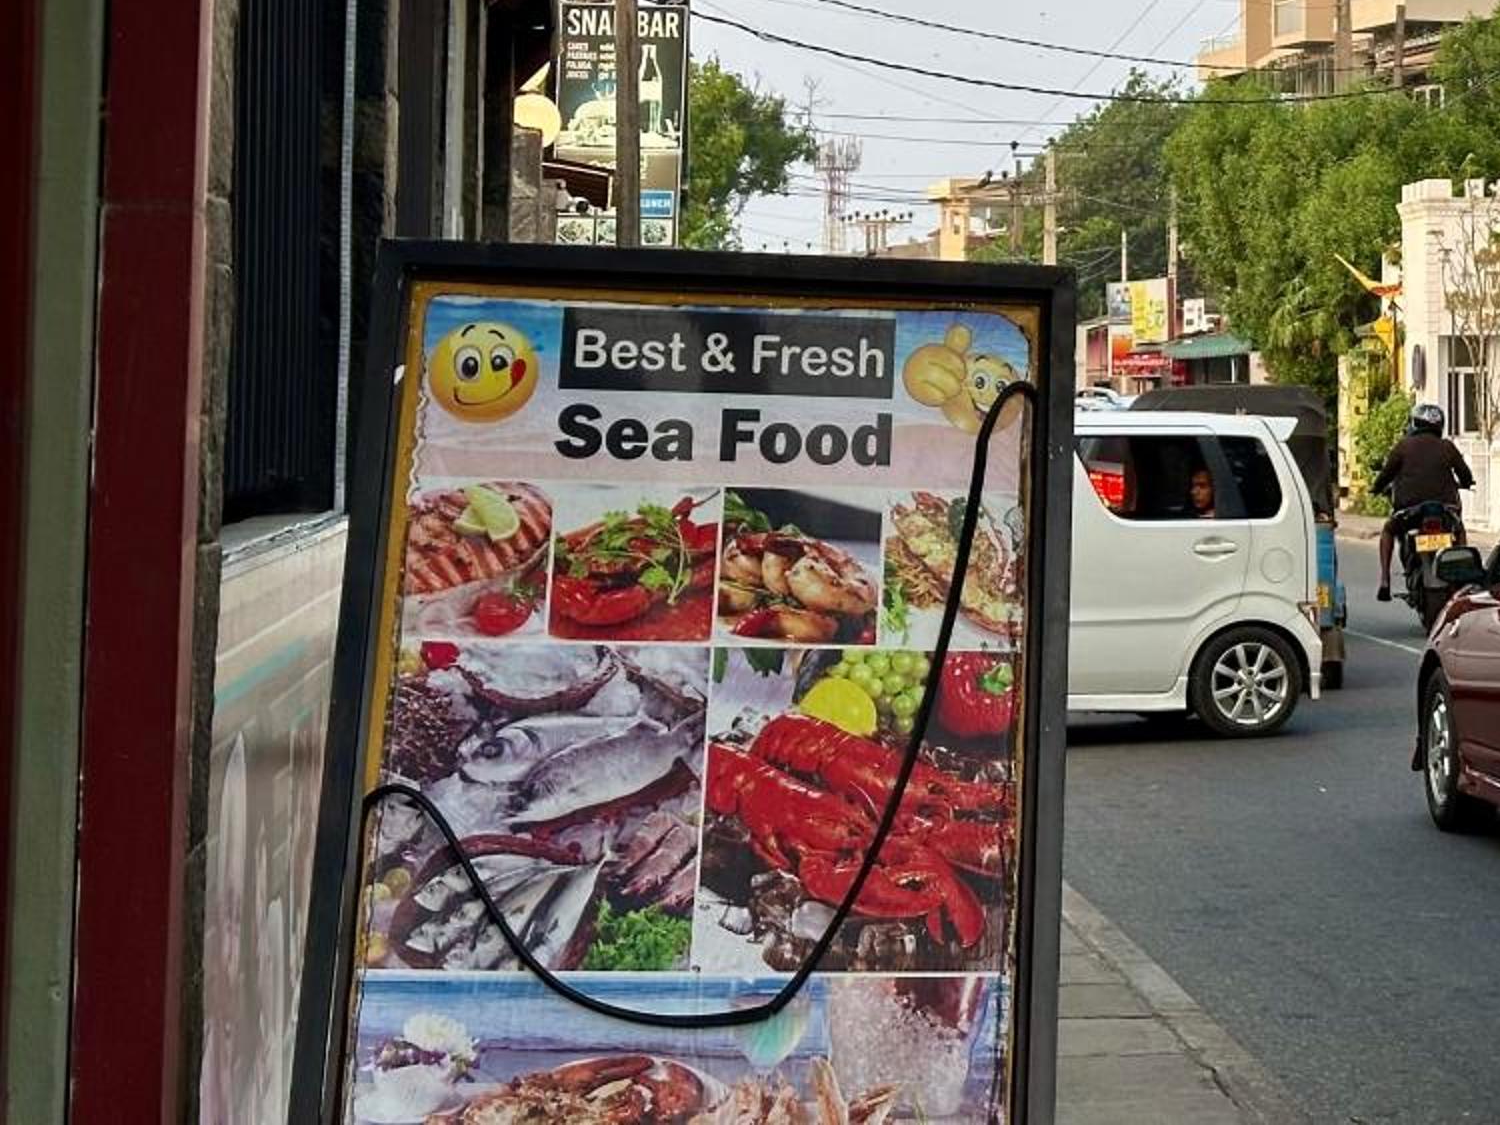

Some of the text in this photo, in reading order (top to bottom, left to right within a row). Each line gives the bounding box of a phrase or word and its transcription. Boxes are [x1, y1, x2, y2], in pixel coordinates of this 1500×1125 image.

[638, 11, 679, 38] BAR
[575, 329, 885, 378] Best & Fresh
[554, 403, 893, 467] Sea Food
